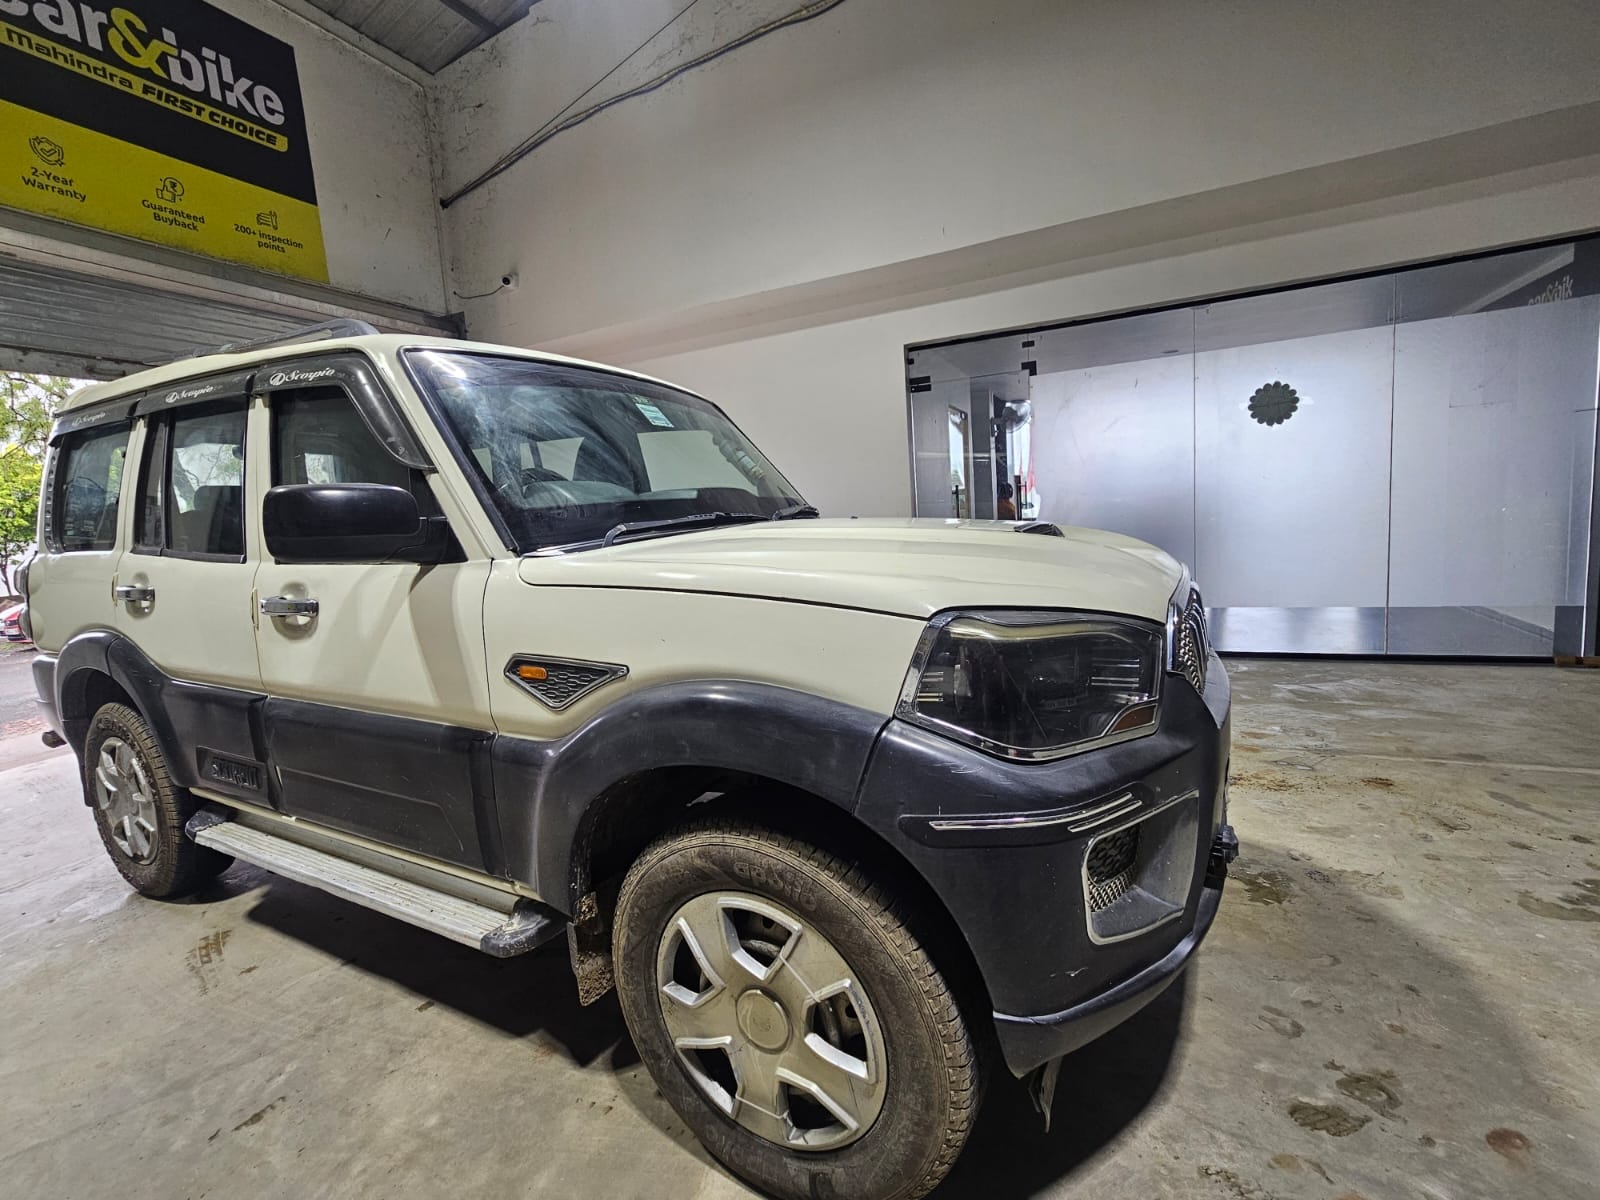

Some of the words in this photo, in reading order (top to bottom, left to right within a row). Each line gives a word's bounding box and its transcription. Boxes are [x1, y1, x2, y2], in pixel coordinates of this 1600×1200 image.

[6, 27, 133, 90] mahindra
[142, 83, 206, 117] FIRST
[208, 111, 278, 146] CHOICE
[21, 175, 87, 203] Warranty
[30, 166, 74, 187] 2-Year
[142, 199, 206, 225] Guaranteed
[153, 212, 199, 232] Buyback
[234, 223, 257, 236] 200+
[258, 230, 304, 249] inspection
[257, 240, 286, 254] points
